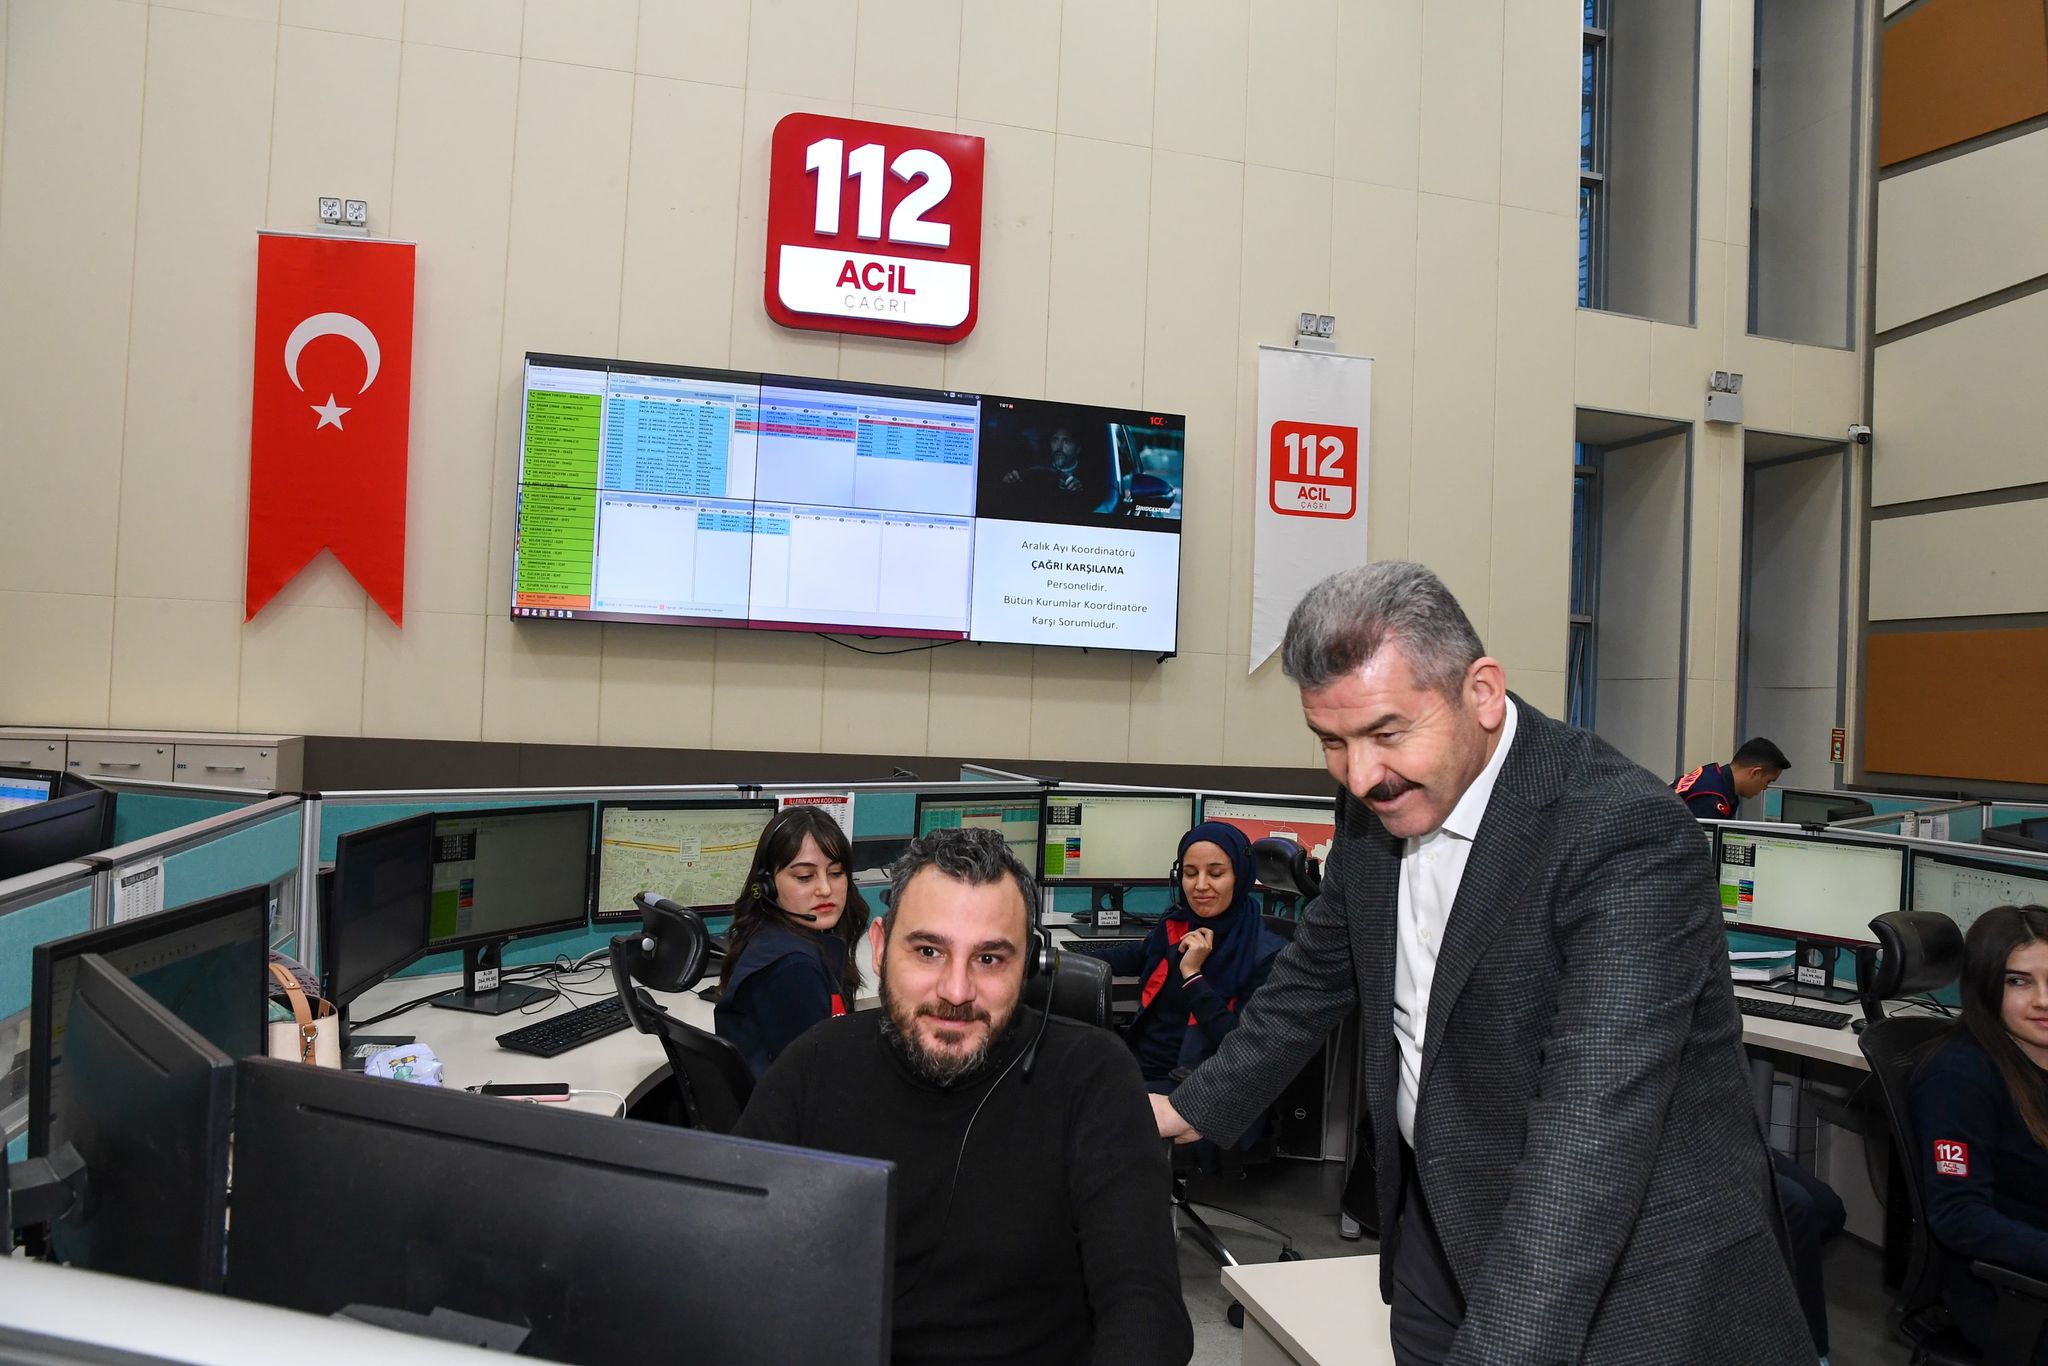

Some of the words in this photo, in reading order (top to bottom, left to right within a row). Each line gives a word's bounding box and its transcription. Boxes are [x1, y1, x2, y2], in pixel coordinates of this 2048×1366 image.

[805, 137, 953, 248] 112
[844, 294, 906, 314] ÇAĞRI
[1284, 432, 1345, 478] 112
[1300, 501, 1327, 510] ÇAĞRI
[1021, 540, 1050, 551] Aralık
[1053, 543, 1069, 553] Ayı
[1071, 544, 1136, 558] Koordinatörü
[1031, 559, 1063, 571] ÇAĞRI
[1066, 562, 1124, 575] KARŞILAMA
[1046, 579, 1107, 592] Personelidir.
[1003, 595, 1033, 606] Bütün
[1036, 597, 1081, 609] Kurumlar
[1084, 600, 1148, 613] Koordinatöre
[1032, 615, 1056, 627] Karşı
[1058, 617, 1119, 630] Sorumludur.
[1937, 1144, 1964, 1161] 112
